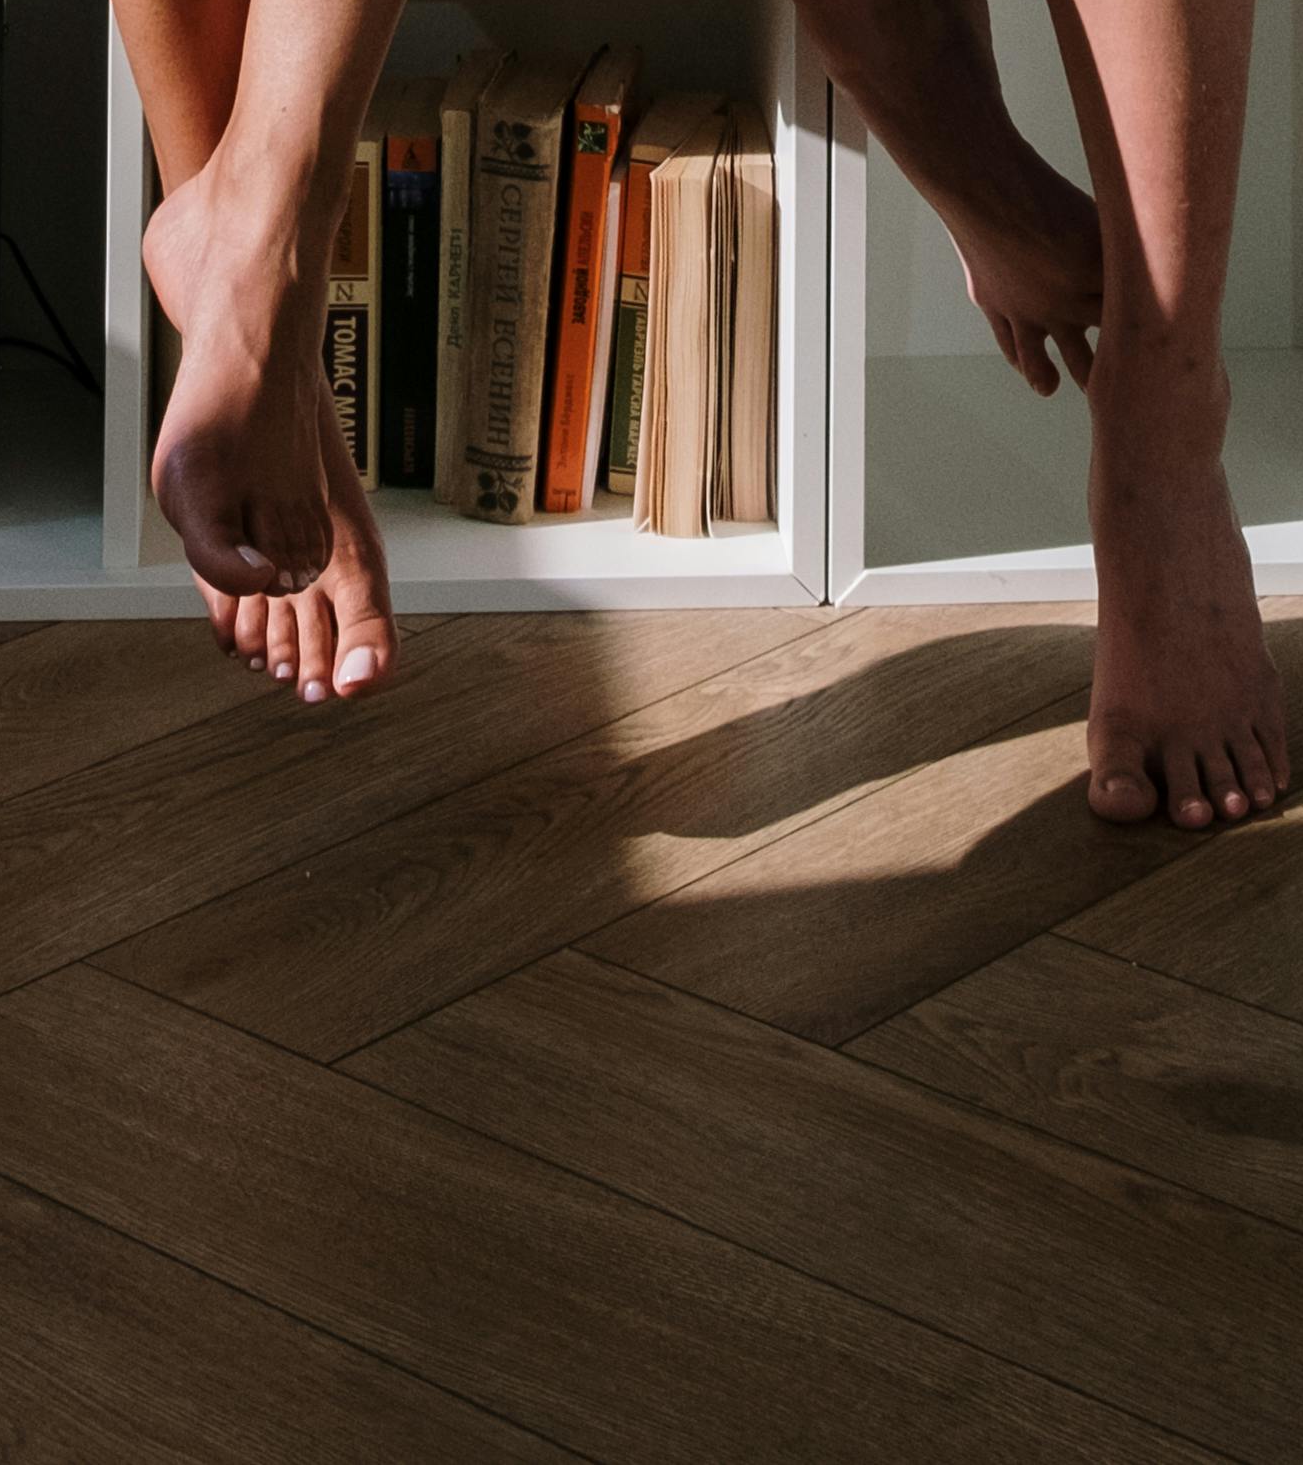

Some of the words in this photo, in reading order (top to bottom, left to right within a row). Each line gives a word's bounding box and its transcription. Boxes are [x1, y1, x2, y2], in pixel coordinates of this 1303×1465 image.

[495, 183, 523, 303] СЕРГЕЙ
[573, 268, 592, 325] ЗАВОДНОЙ
[333, 316, 357, 391] ТОМАС
[487, 315, 517, 448] ЕСЕНИН
[631, 373, 644, 417] ГАРСИА
[626, 419, 642, 467] МАРКЕС
